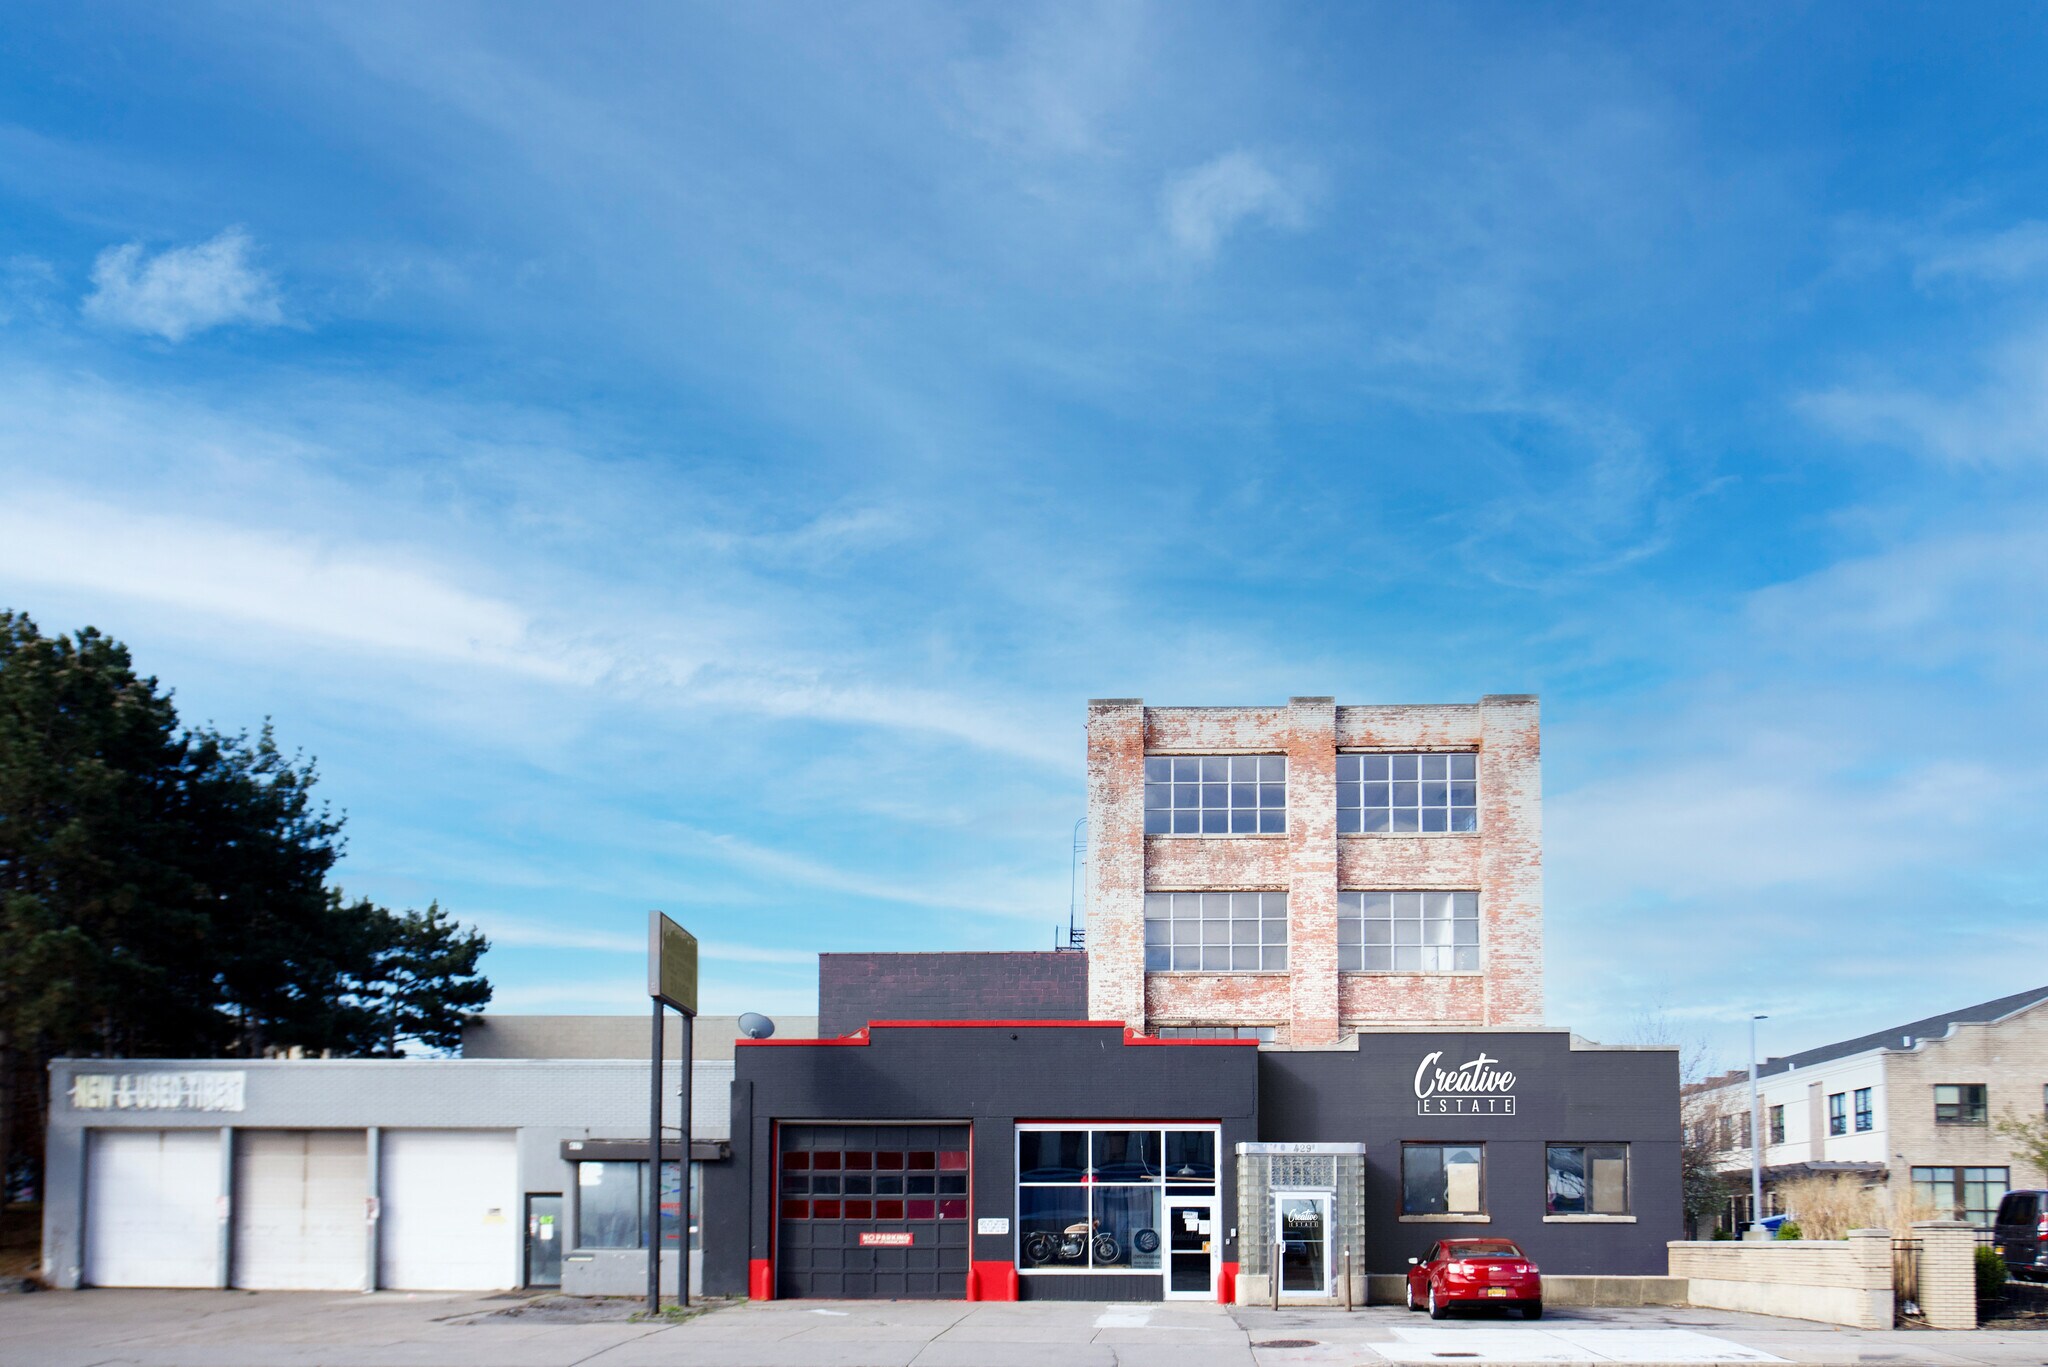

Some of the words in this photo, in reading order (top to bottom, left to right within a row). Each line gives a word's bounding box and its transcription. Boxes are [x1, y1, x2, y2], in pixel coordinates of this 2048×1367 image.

[1415, 1051, 1516, 1098] Creative
[75, 1075, 112, 1107] NEW
[135, 1074, 181, 1108] USED
[1424, 1100, 1511, 1112] ESTATE
[1288, 1209, 1319, 1222] Creative
[862, 1233, 875, 1241] NO
[876, 1233, 911, 1241] PARKING
